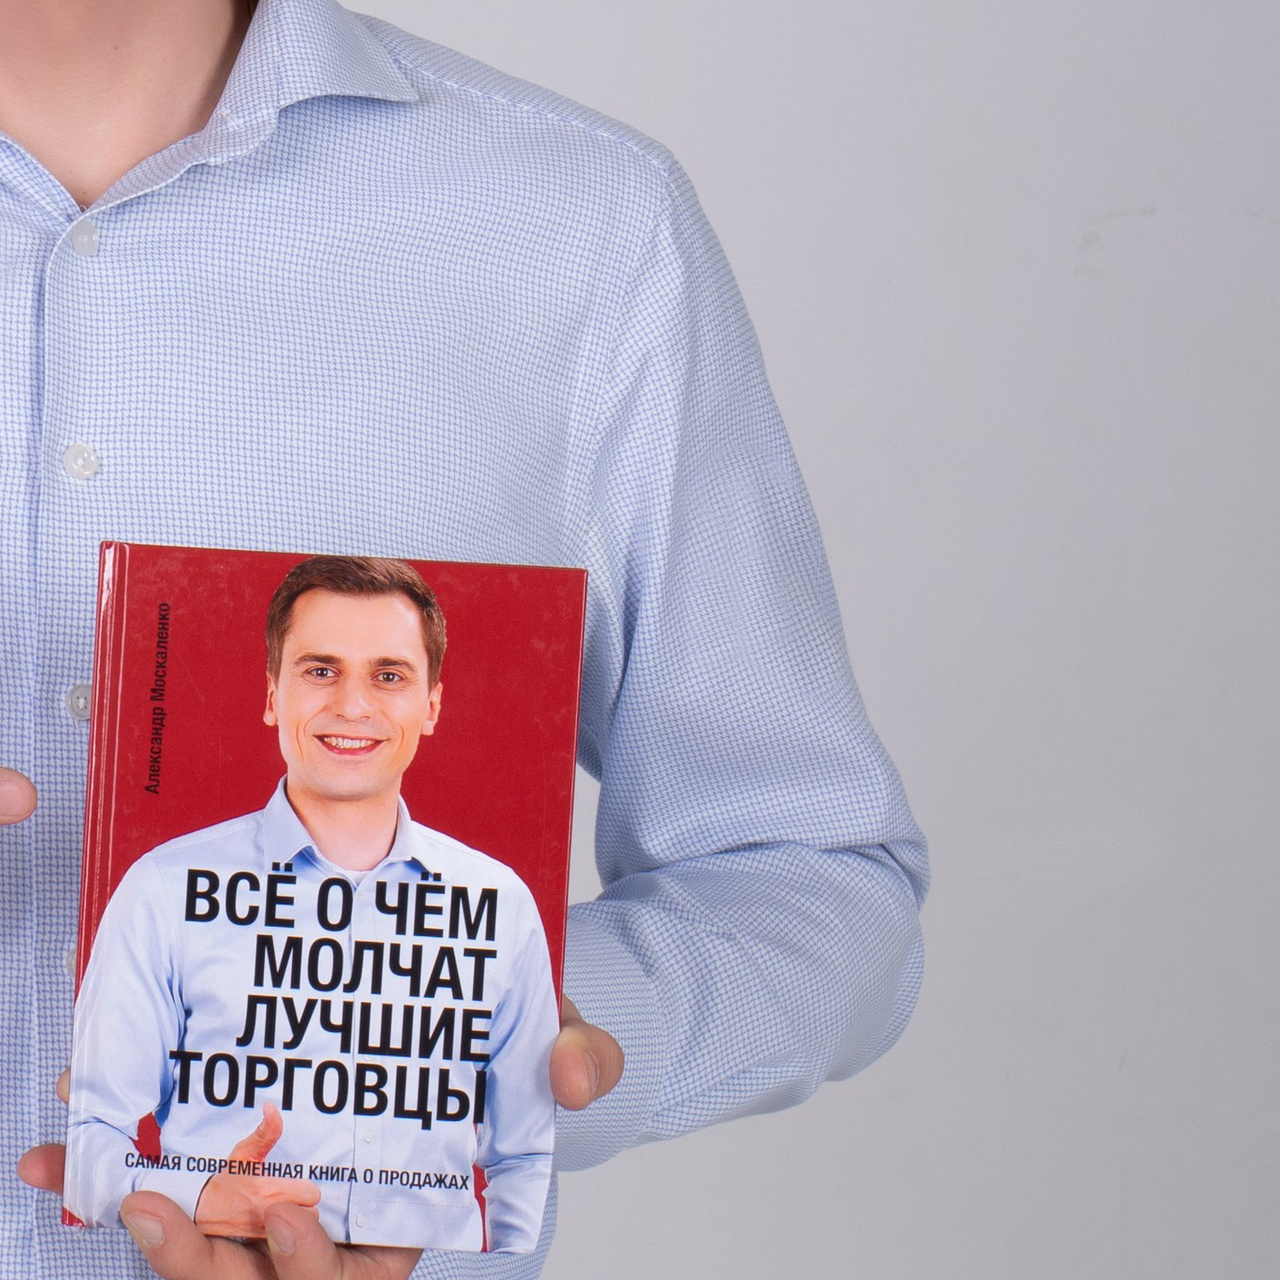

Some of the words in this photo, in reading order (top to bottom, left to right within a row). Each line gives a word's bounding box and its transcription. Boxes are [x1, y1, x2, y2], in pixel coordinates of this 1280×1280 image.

[149, 602, 171, 702] Москаленко
[144, 706, 167, 795] Александр
[185, 861, 297, 929] ВСЁ
[316, 877, 354, 932] О
[375, 871, 498, 941] ЧЁМ
[253, 933, 498, 1002] МОЛЧАТ
[235, 994, 493, 1063] ЛУЧШИЕ
[169, 1050, 487, 1131] ТОРГОВЦЫ
[125, 1152, 181, 1171] САМАЯ
[186, 1156, 304, 1180] СОВРЕМЕННАЯ
[308, 1164, 358, 1183] КНИГА
[363, 1168, 373, 1184] О
[378, 1170, 470, 1191] ПРОДАЖАХ
